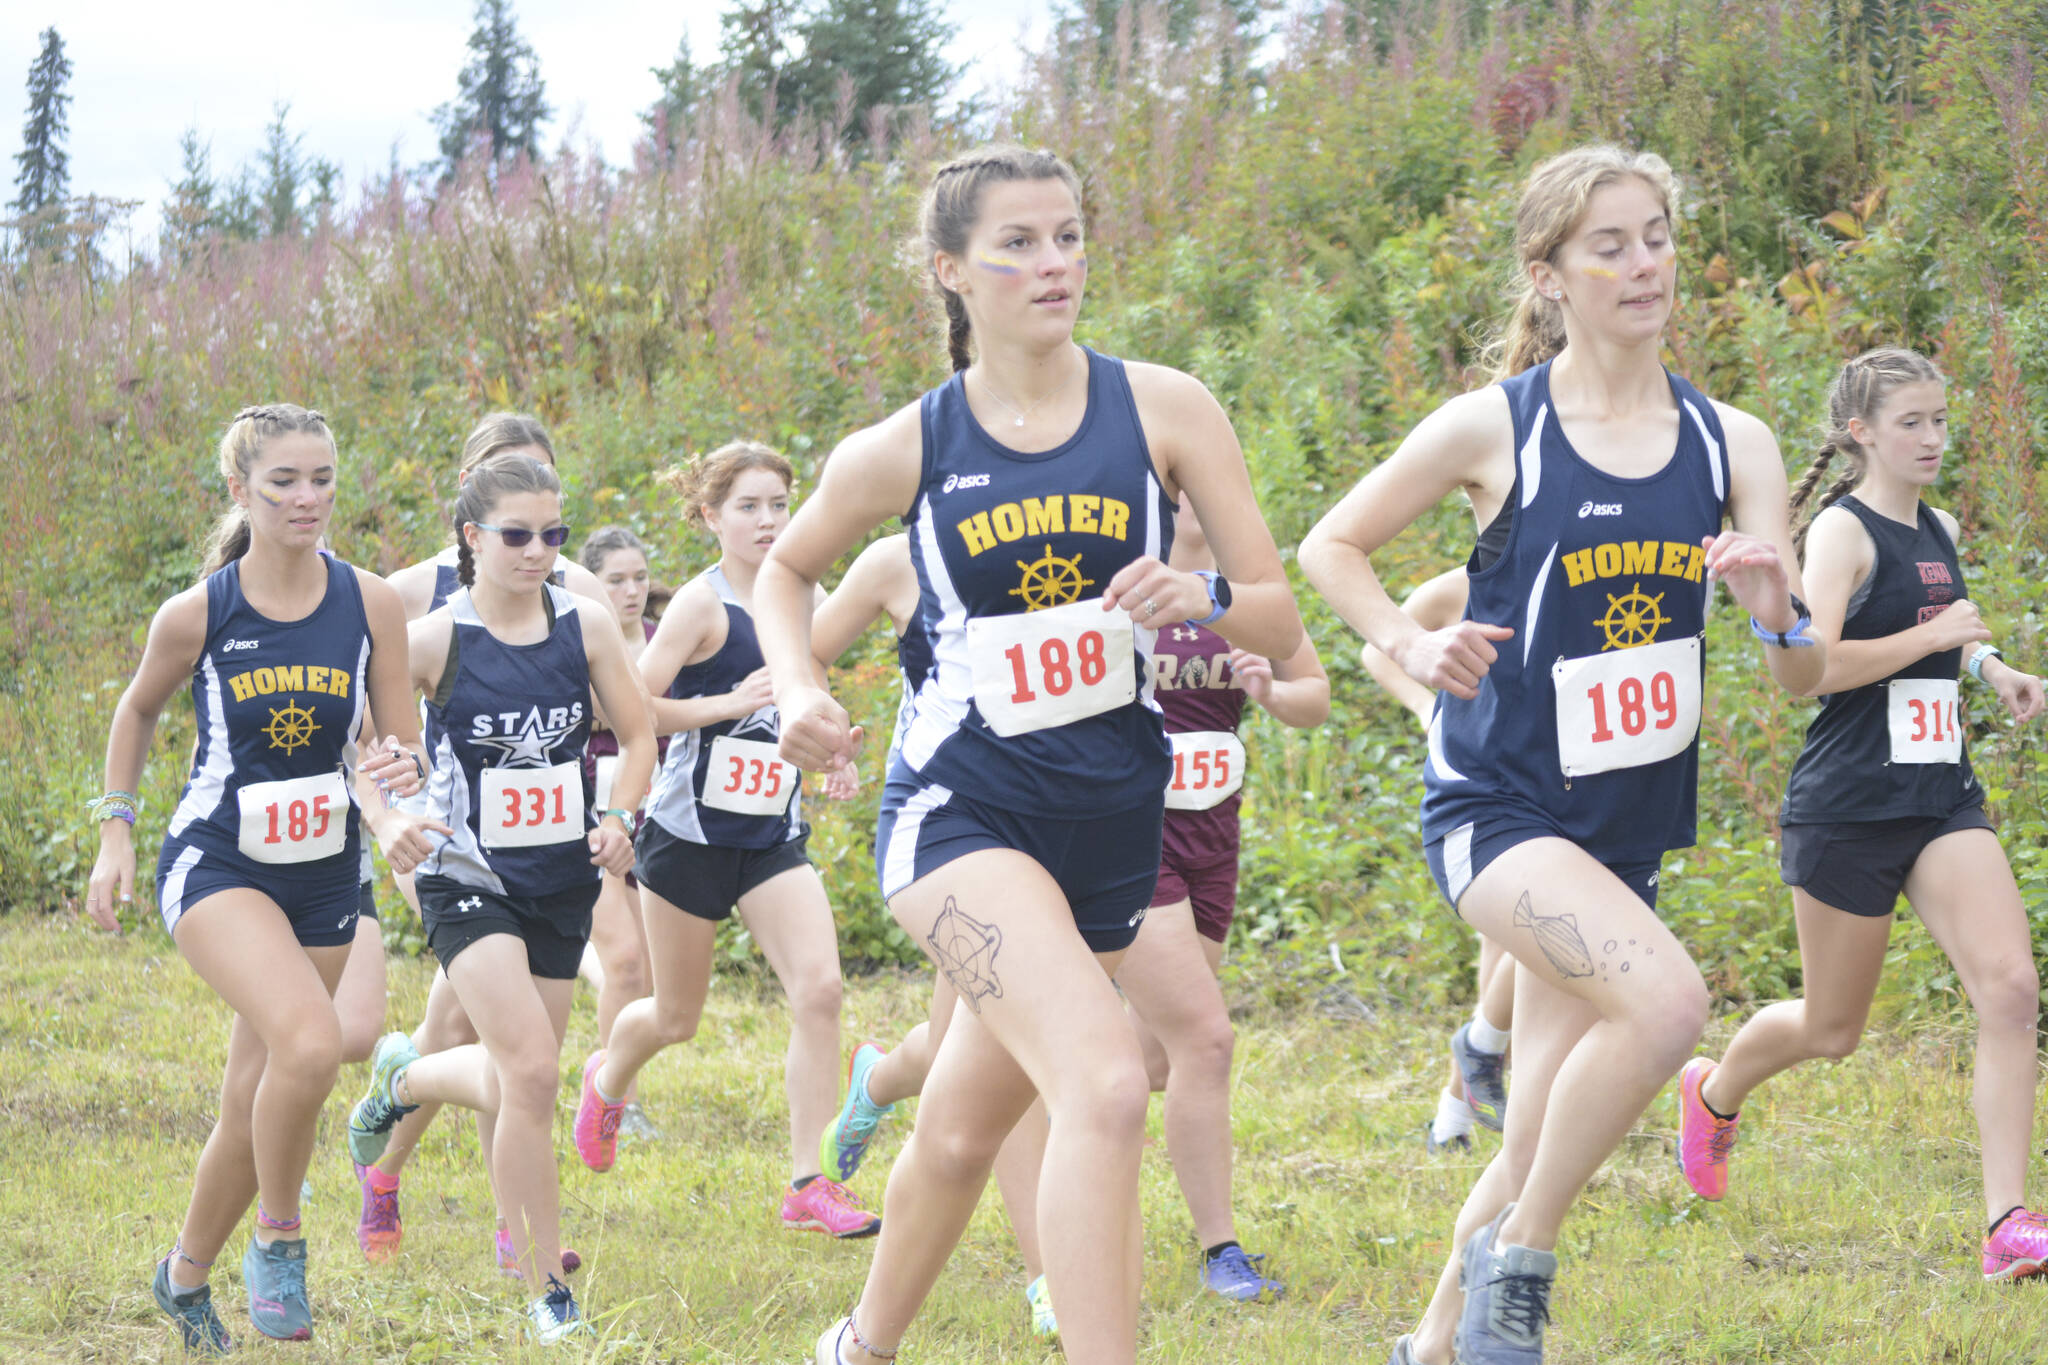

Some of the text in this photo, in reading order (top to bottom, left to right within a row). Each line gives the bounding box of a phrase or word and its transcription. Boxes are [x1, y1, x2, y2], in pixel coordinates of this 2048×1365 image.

[957, 474, 990, 488] asics
[957, 494, 1130, 557] HOMER
[1593, 503, 1622, 516] asics
[1561, 541, 1706, 587] HOMER
[234, 639, 259, 650] asics
[228, 665, 350, 702] HOMER
[1005, 630, 1107, 704] 188
[472, 702, 583, 737] STARS
[1587, 671, 1677, 743] 189
[723, 756, 783, 798] 335
[1171, 749, 1229, 790] 155
[264, 795, 330, 844] 185
[502, 784, 566, 828] 331
